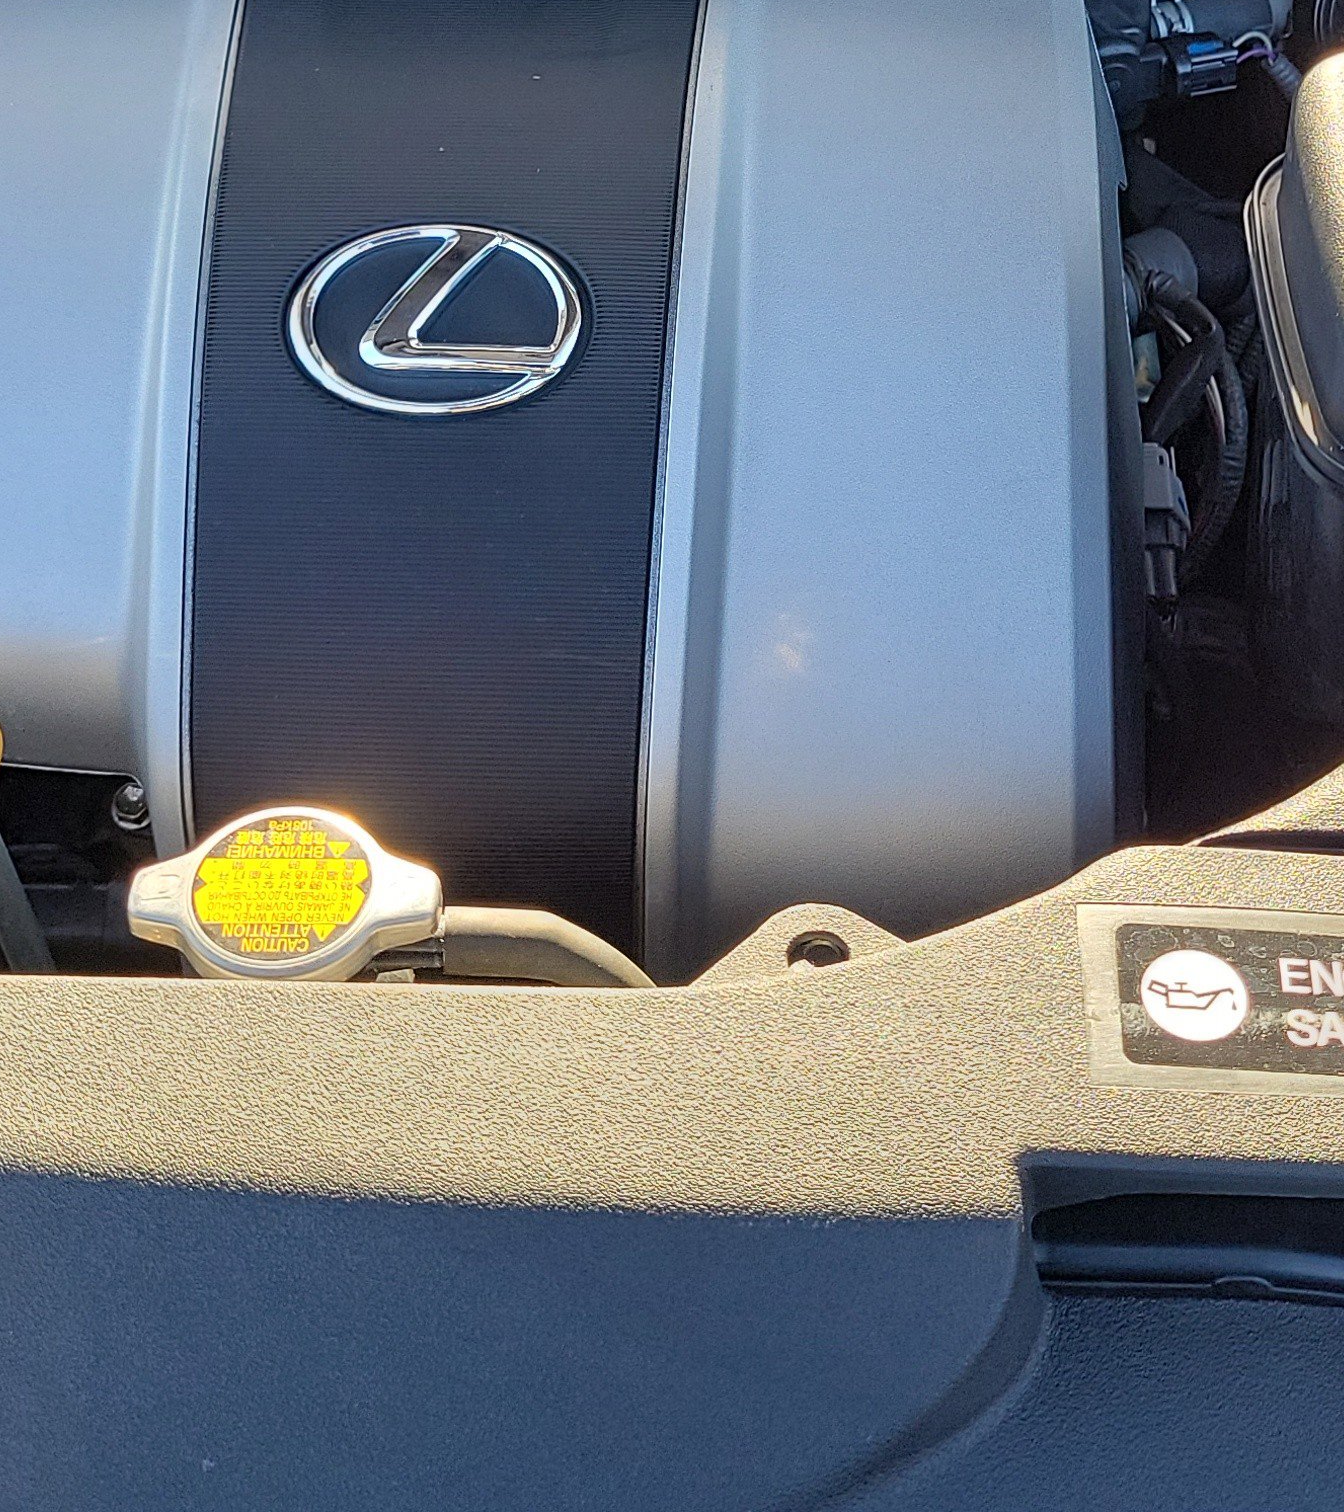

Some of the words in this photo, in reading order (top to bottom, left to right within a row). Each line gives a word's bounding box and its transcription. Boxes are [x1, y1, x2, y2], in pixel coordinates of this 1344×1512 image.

[225, 844, 326, 859] ВНИМАНИЕ!
[207, 901, 243, 911] CHAUD
[256, 901, 294, 911] OUVRIR
[297, 902, 335, 911] JAMAIS
[339, 902, 351, 911] NE
[206, 911, 232, 922] HOT
[233, 912, 268, 922] WHEN
[270, 912, 303, 923] OPEN
[306, 912, 345, 923] NEVER
[222, 923, 312, 938] ATTENTION
[241, 938, 310, 953] CAUTION
